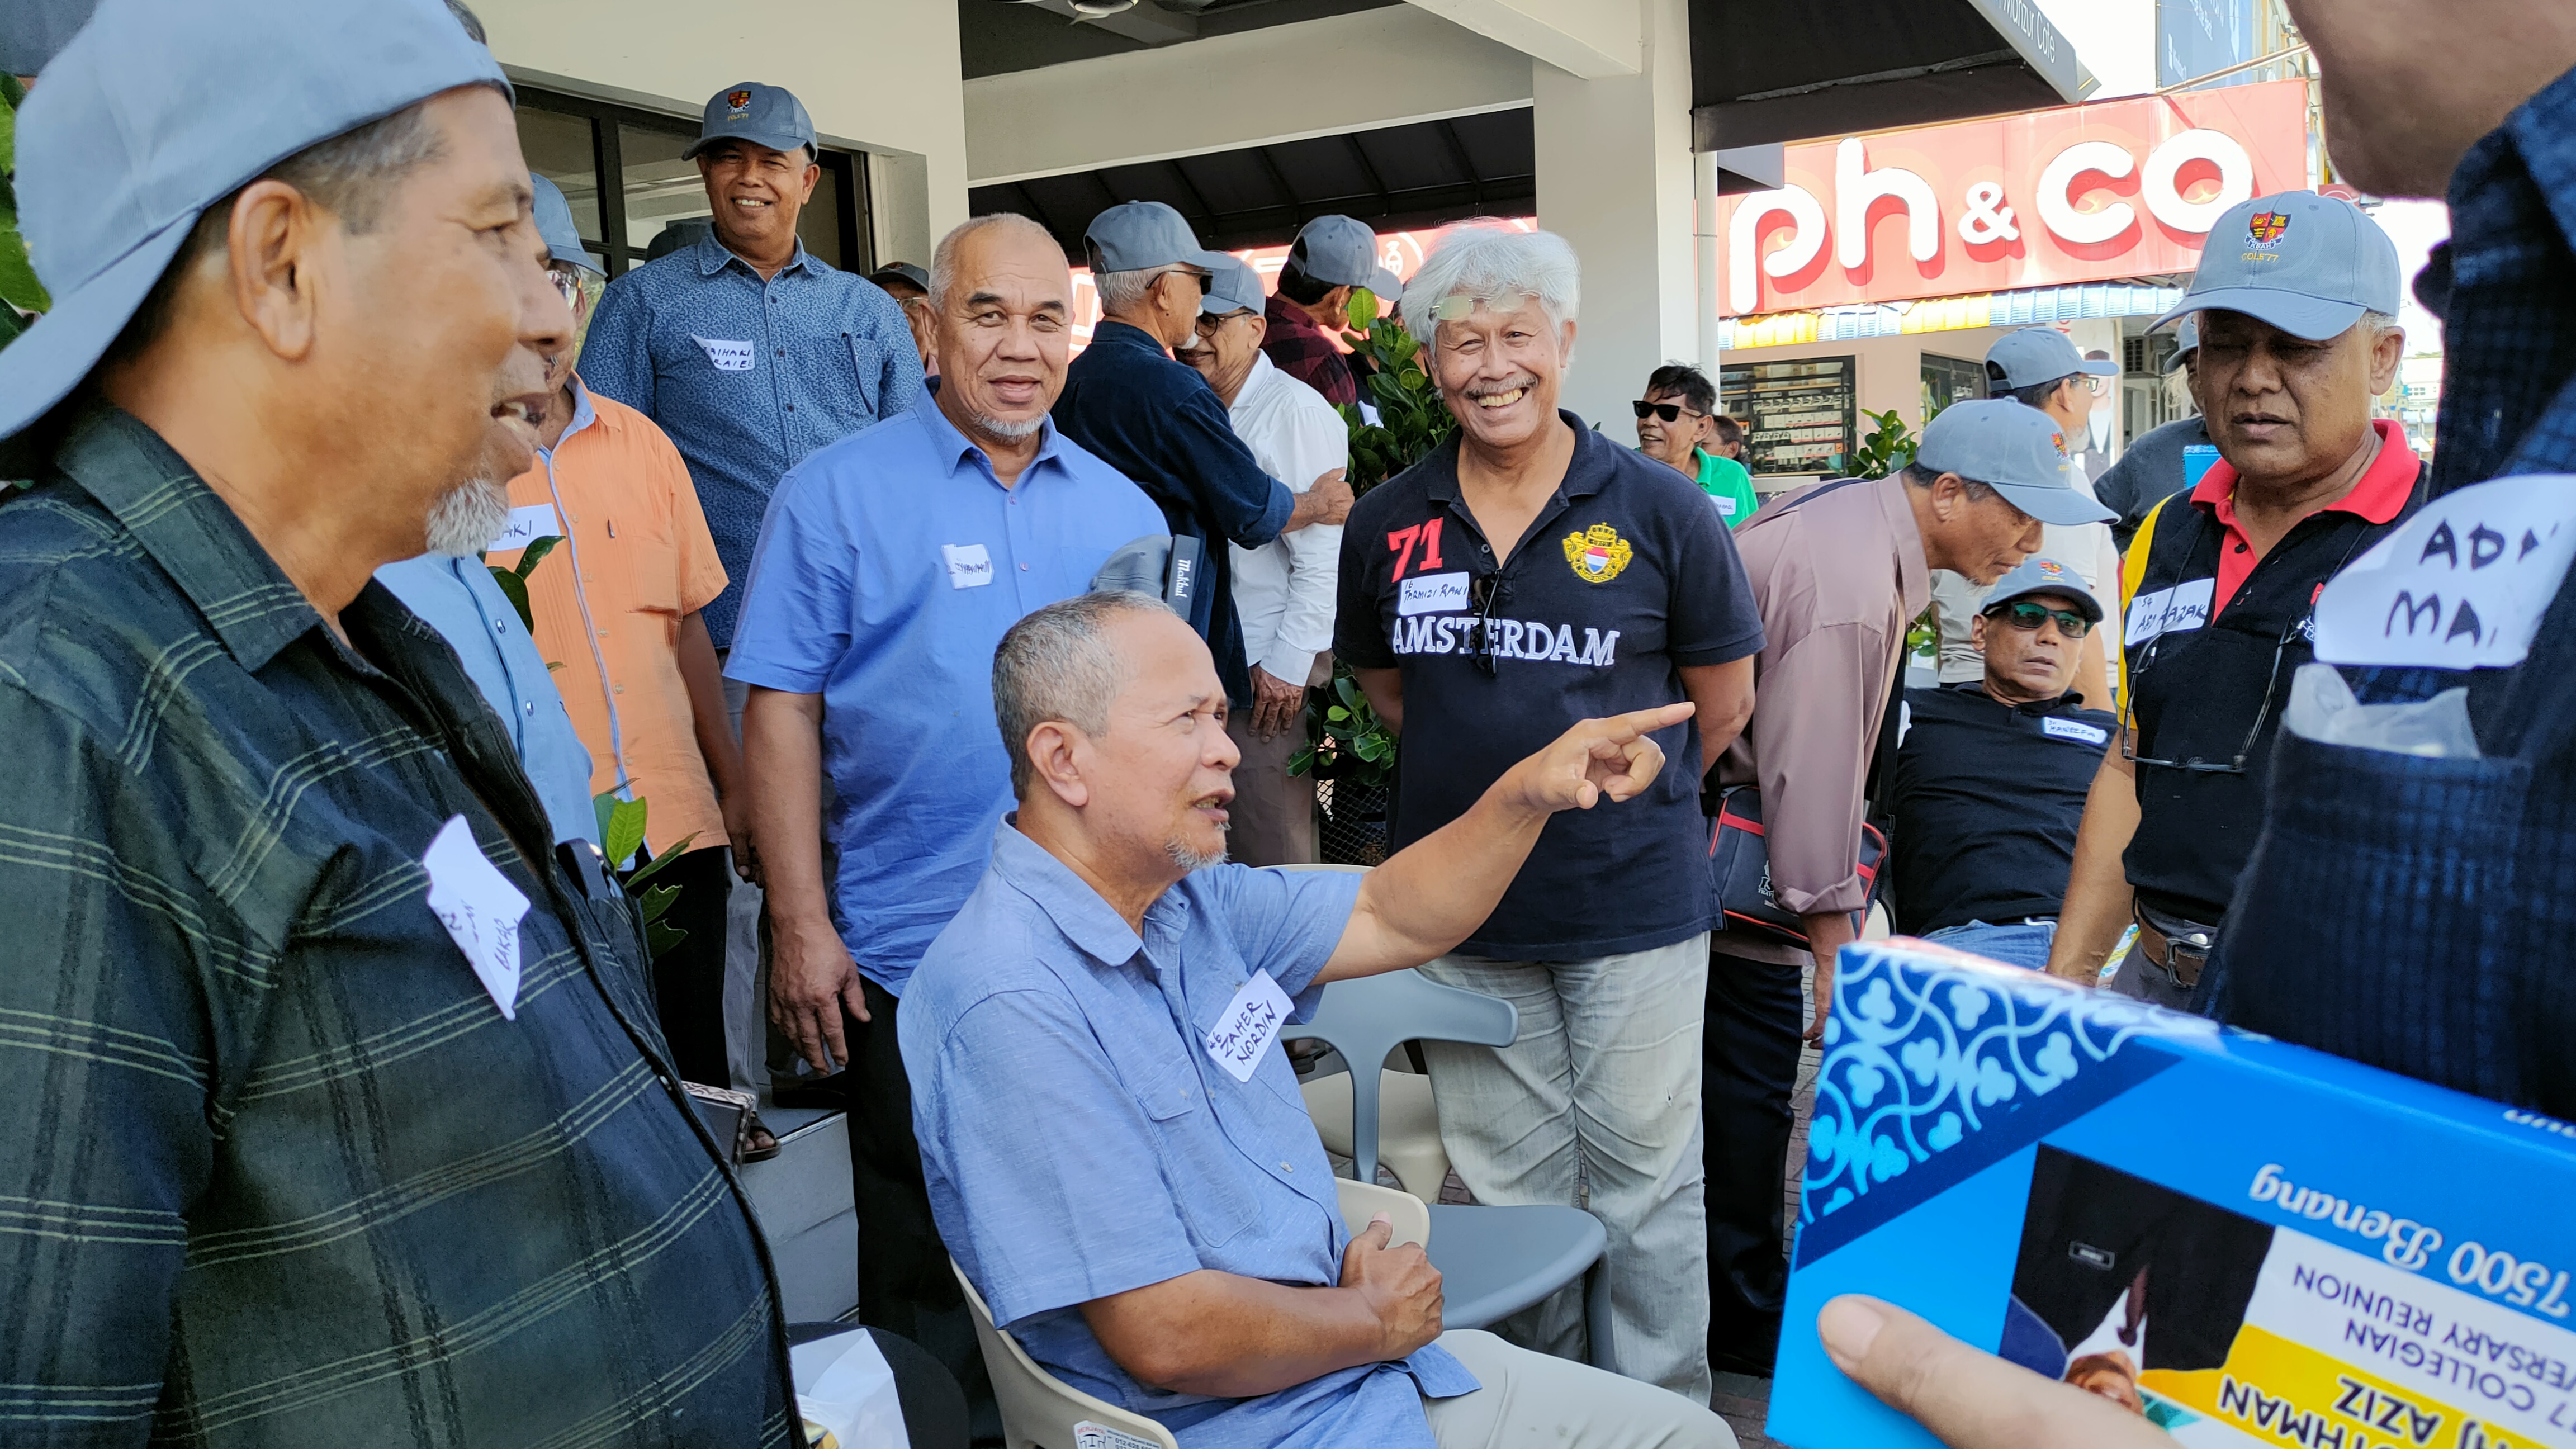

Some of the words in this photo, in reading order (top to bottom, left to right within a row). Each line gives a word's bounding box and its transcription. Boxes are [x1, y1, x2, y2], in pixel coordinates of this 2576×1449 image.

[2037, 11, 2055, 63] Cafe
[1176, 559, 1191, 598] Makbul
[1388, 517, 1443, 583] 71
[1393, 616, 1620, 666] AMSTERDAM
[1207, 1031, 1222, 1050] 46
[1220, 1002, 1263, 1058] ZAHER
[1237, 1000, 1277, 1066] NORDIN
[2248, 1163, 2443, 1270] Benang
[2293, 1264, 2433, 1337] REUNION
[2447, 1242, 2571, 1318] 7500
[2345, 1319, 2536, 1412] COLLEGIAN
[2219, 1377, 2398, 1449] HMAN
[2337, 1377, 2440, 1443] AZIZ
